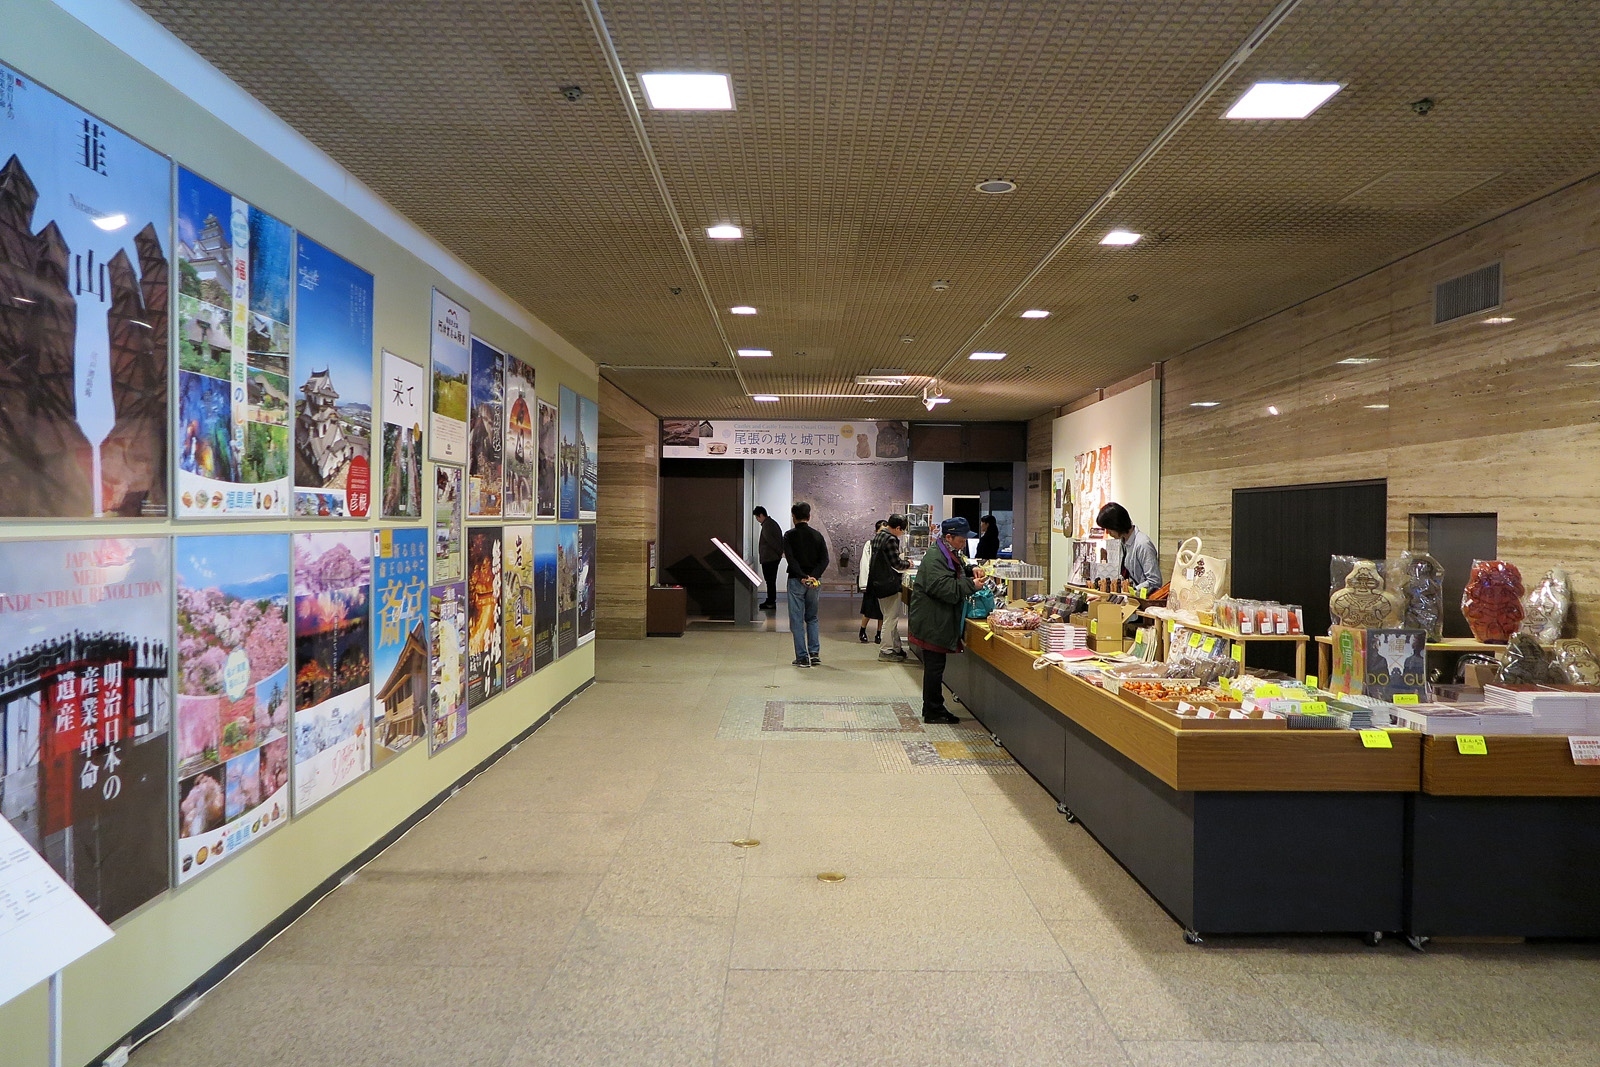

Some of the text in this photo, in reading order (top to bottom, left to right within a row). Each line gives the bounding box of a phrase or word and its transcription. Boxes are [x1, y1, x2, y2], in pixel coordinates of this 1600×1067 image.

[734, 432, 840, 447] 尾張の城と城下町
[734, 447, 836, 456] 三英傑の城づくり・町づくり
[350, 492, 367, 511] 彦根
[1389, 638, 1405, 668] 縄文
[55, 670, 76, 734] 遺産
[79, 666, 100, 790] 産業革命
[102, 661, 123, 801] 明治日本の
